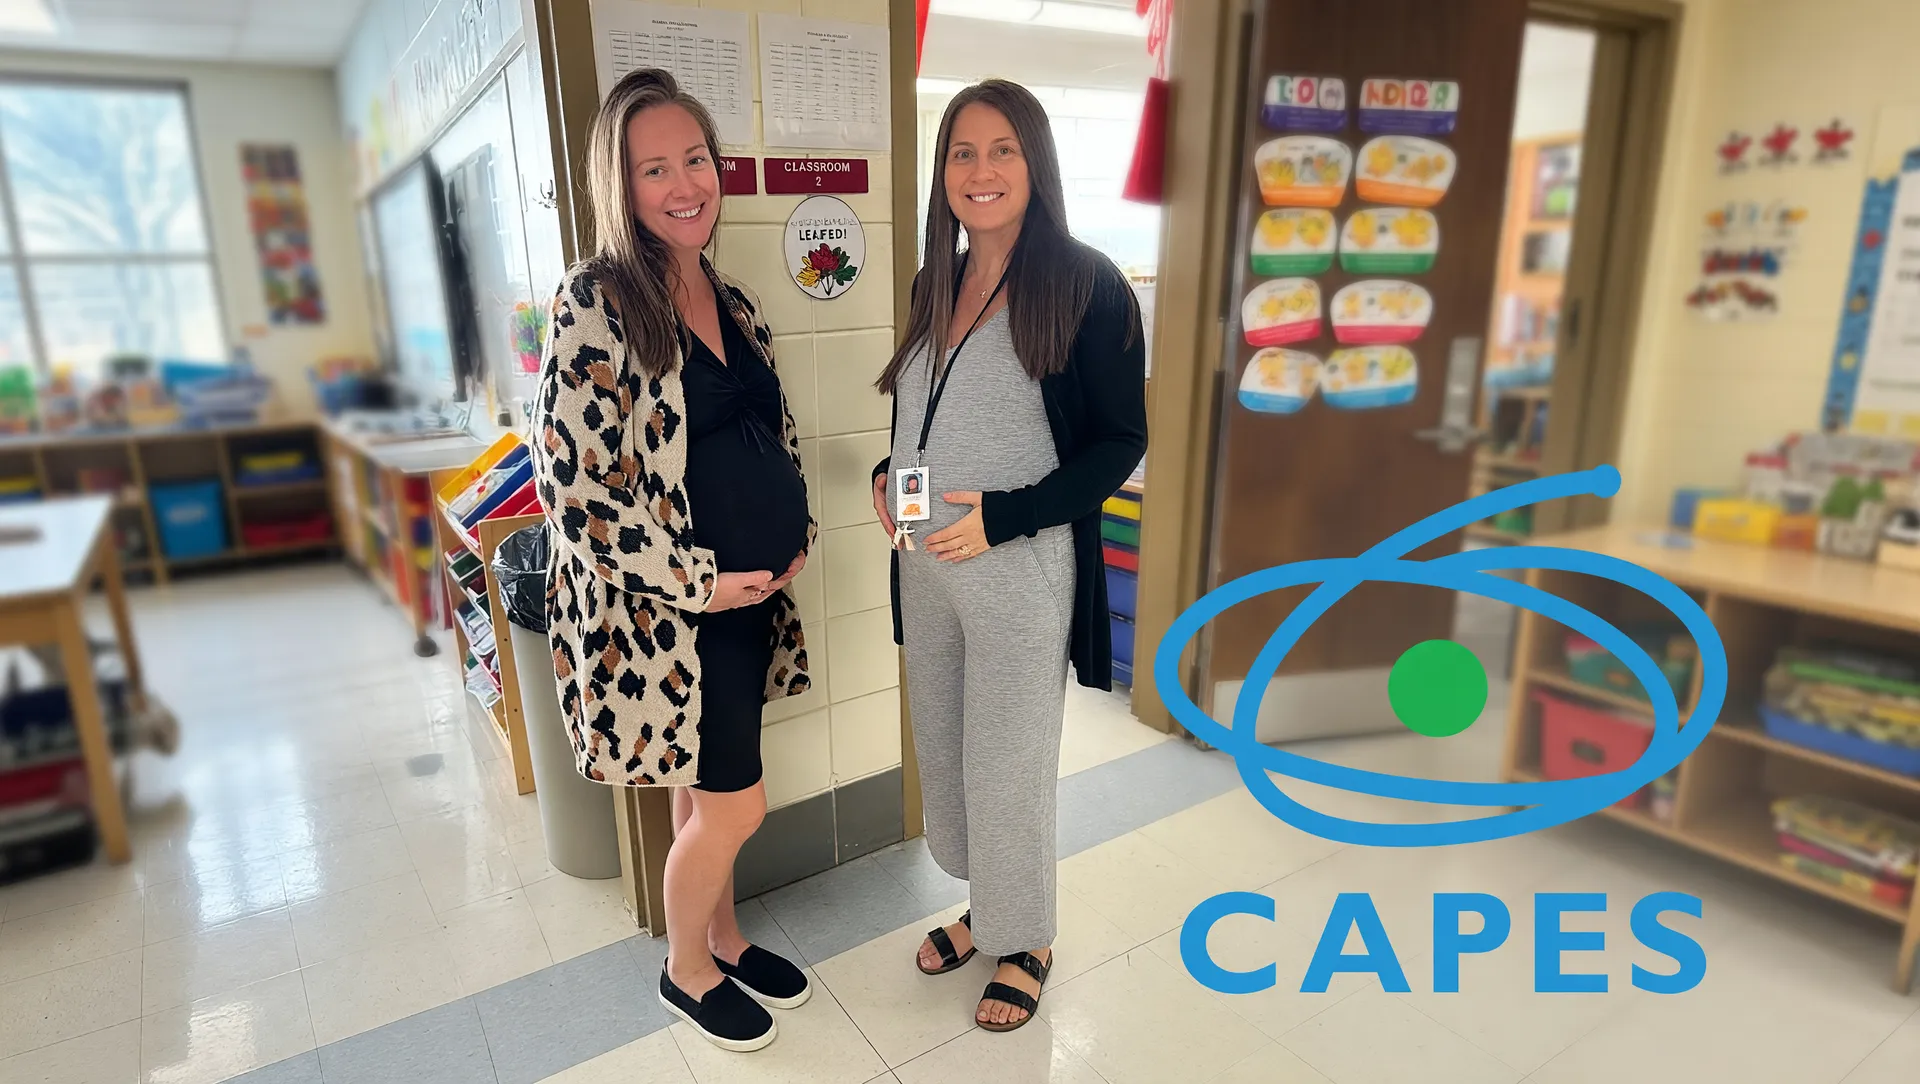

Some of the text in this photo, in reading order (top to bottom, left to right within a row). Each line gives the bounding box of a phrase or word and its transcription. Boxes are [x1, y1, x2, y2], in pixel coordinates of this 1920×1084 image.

[784, 161, 850, 172] CLASSROOM
[815, 176, 822, 187] 2
[799, 228, 847, 241] LEAFED!
